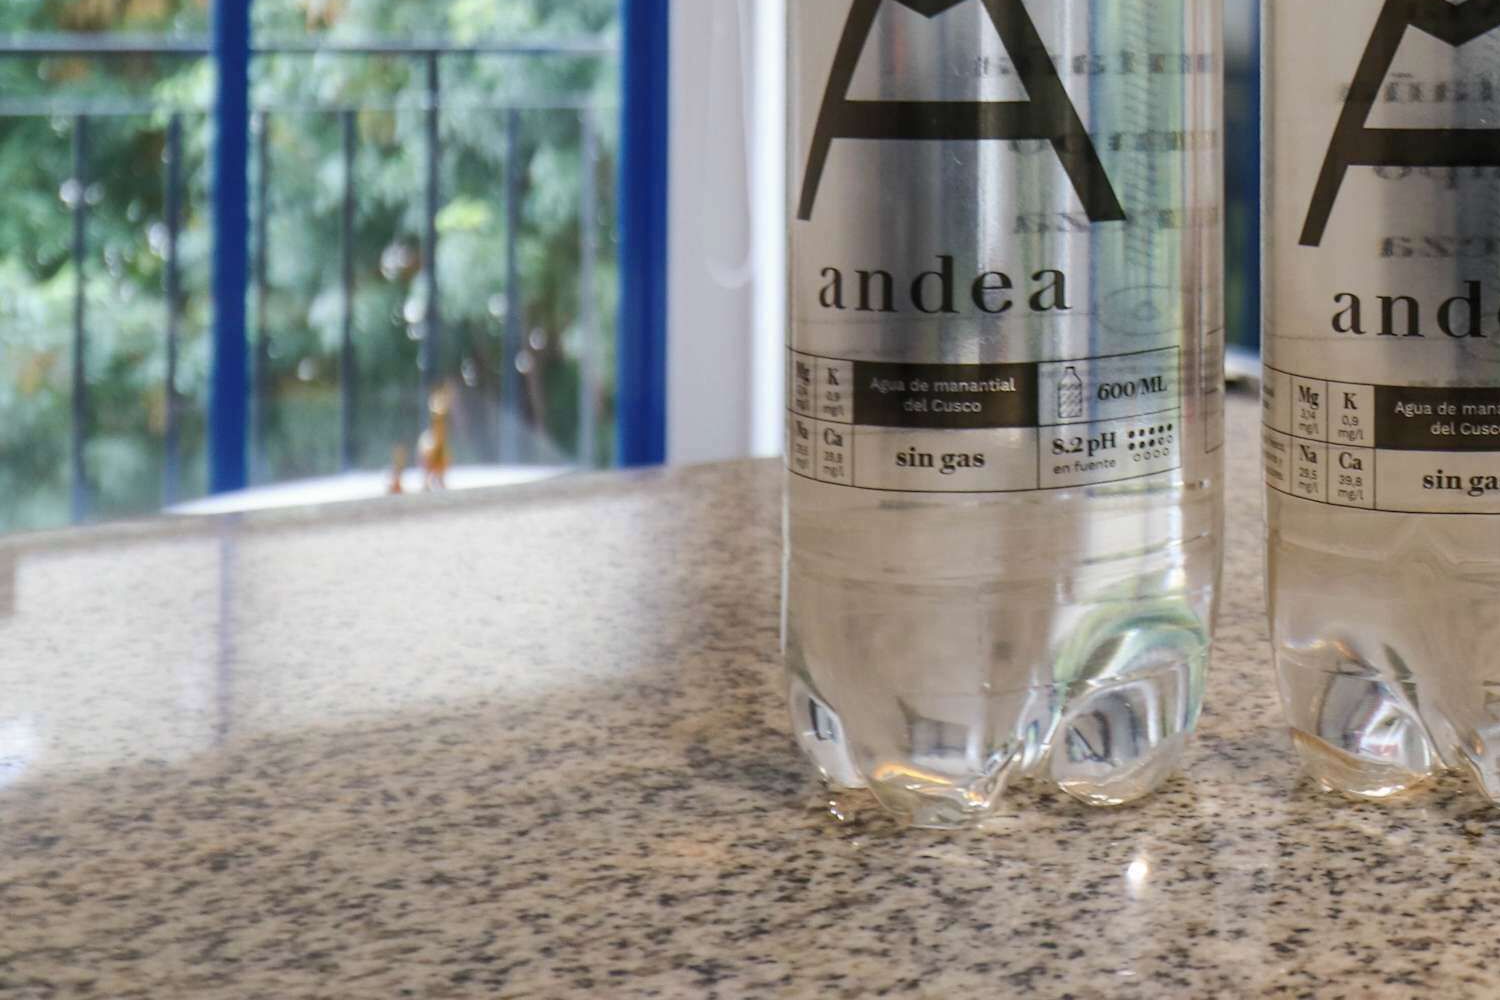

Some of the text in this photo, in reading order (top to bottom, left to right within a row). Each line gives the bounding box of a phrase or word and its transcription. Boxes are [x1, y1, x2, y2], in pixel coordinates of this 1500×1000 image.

[818, 254, 1073, 314] andea
[870, 377, 1016, 393] Agua de manantial
[904, 399, 982, 412] del Cusco
[1298, 385, 1319, 410] Mg
[1343, 392, 1358, 410] K
[1395, 401, 1432, 417] Agua
[1437, 402, 1457, 415] de
[1430, 422, 1456, 435] del
[896, 447, 985, 474] sin gas
[1299, 444, 1318, 464] Na
[1339, 451, 1363, 471] Ca
[1053, 459, 1116, 474] en fuente
[1422, 469, 1462, 489] sin
